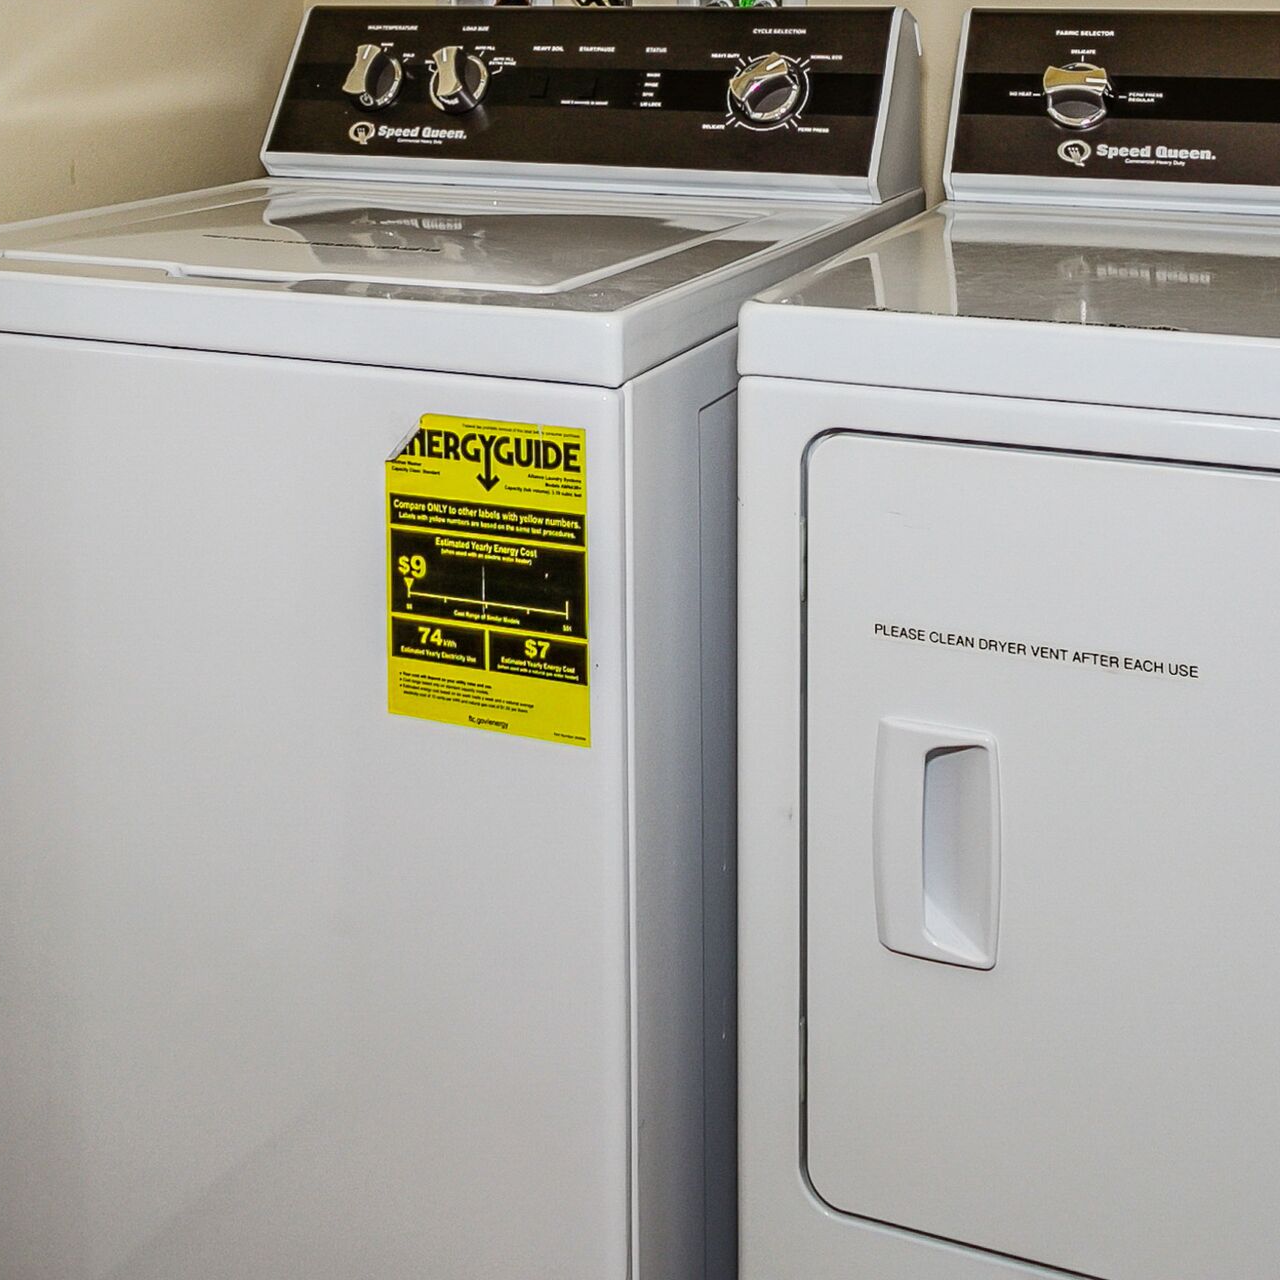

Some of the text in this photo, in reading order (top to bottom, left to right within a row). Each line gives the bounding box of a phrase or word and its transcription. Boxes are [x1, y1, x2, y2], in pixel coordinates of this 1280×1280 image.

[378, 125, 420, 139] Speed
[1096, 144, 1151, 159] Speed
[401, 428, 581, 473] NERGYGUIDE
[393, 499, 581, 529] Compare ONLY to other labels with yellow numbers.
[398, 511, 416, 520] Labels
[417, 513, 428, 521] with
[428, 515, 446, 523] yellow
[447, 517, 470, 526] numbers
[480, 521, 497, 529] based
[505, 523, 515, 531] the
[543, 528, 576, 539] procedures.
[435, 537, 537, 558] Estimated Yearly Energy Cost
[398, 555, 426, 578] $9
[453, 609, 465, 617] Cost
[466, 611, 480, 620] Range
[418, 626, 457, 648] 74 kWh
[401, 645, 477, 663] Estimated Yearly Electricity Use
[524, 639, 550, 659] $7
[874, 623, 1200, 679] PLEASE CLEAN DRYER VENT AFTER EACH USE
[501, 656, 575, 674] Estimated Yearly Energy Cost
